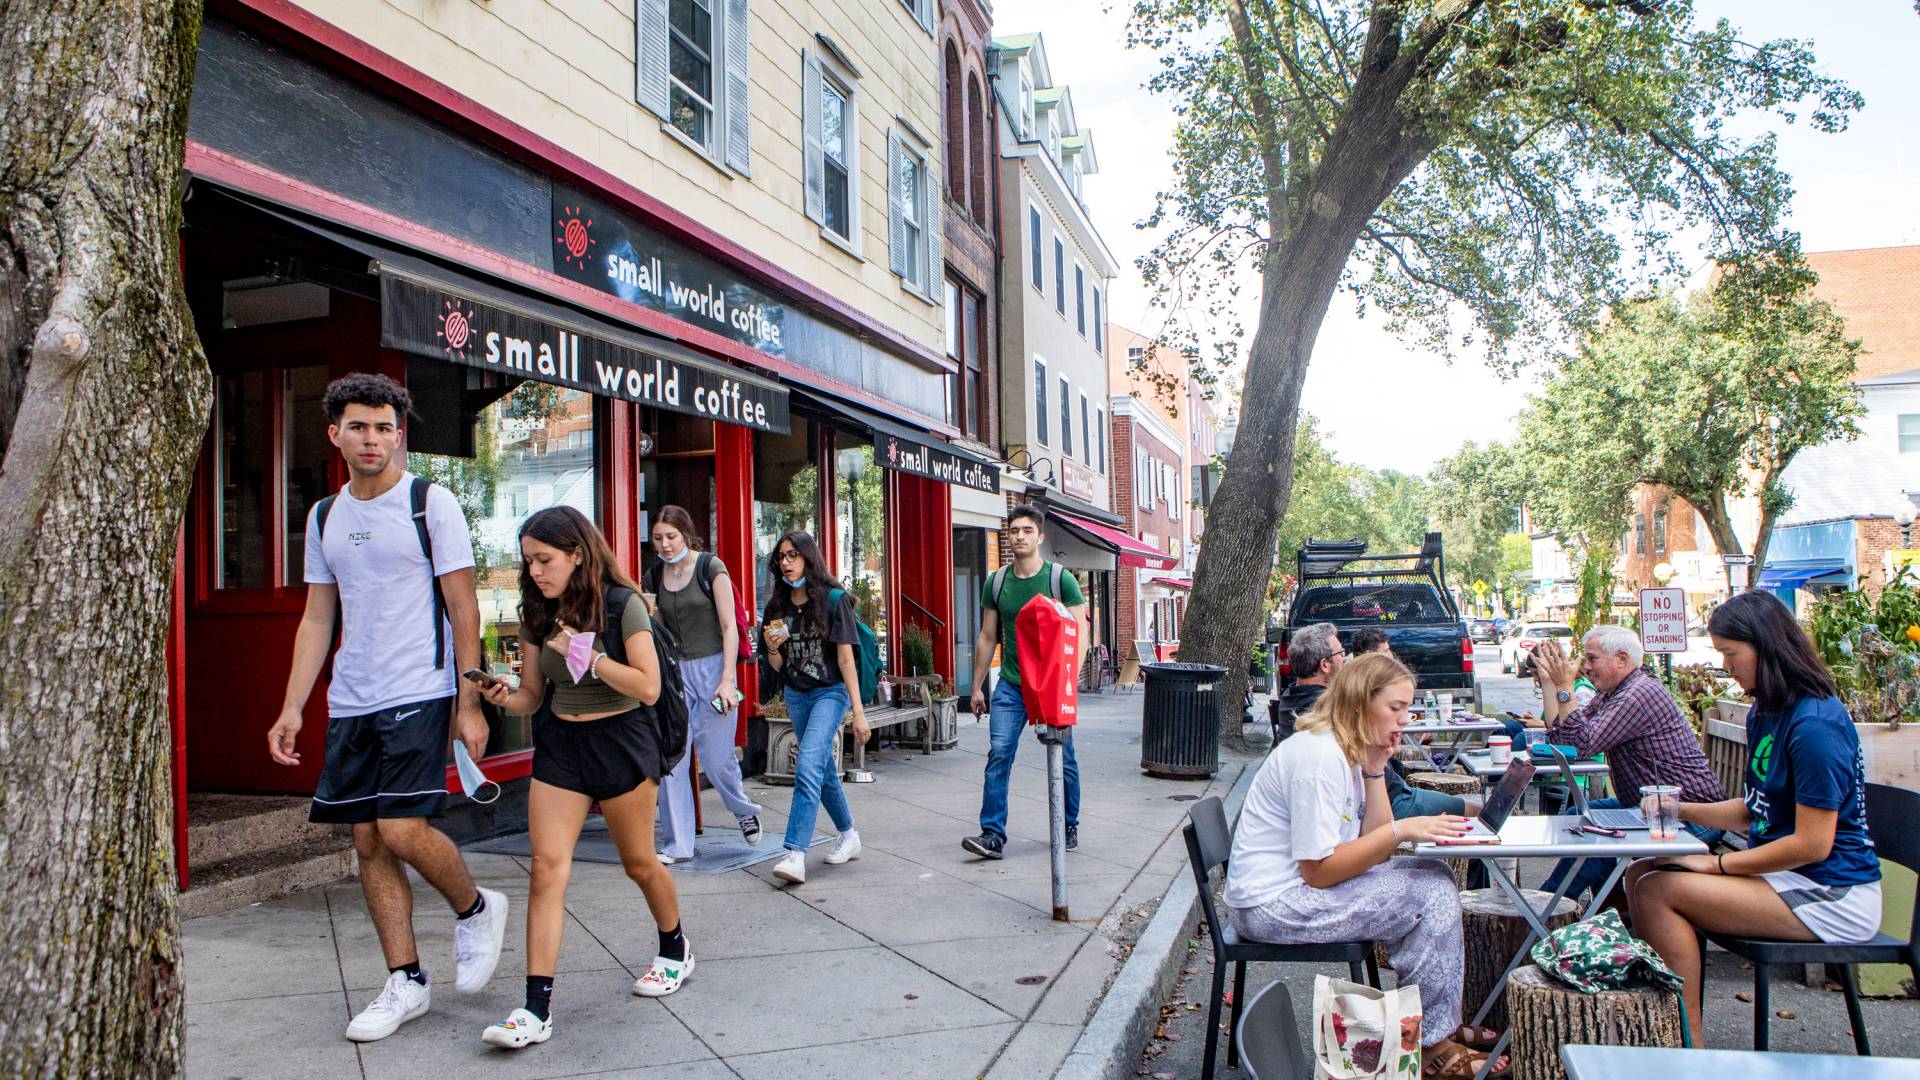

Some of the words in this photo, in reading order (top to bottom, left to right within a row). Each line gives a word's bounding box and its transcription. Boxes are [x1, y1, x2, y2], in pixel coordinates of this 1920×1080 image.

[607, 254, 662, 297] small
[669, 280, 725, 323] world
[731, 304, 780, 345] coffee
[486, 331, 579, 383] small
[595, 359, 680, 406] world
[694, 380, 770, 430] coffee.
[900, 446, 928, 474] small
[932, 456, 961, 482] world
[348, 531, 371, 541] NIKE
[1653, 597, 1671, 609] NO
[1643, 613, 1683, 622] STOPPING
[1658, 624, 1670, 633] OR
[1646, 635, 1683, 644] STANDING
